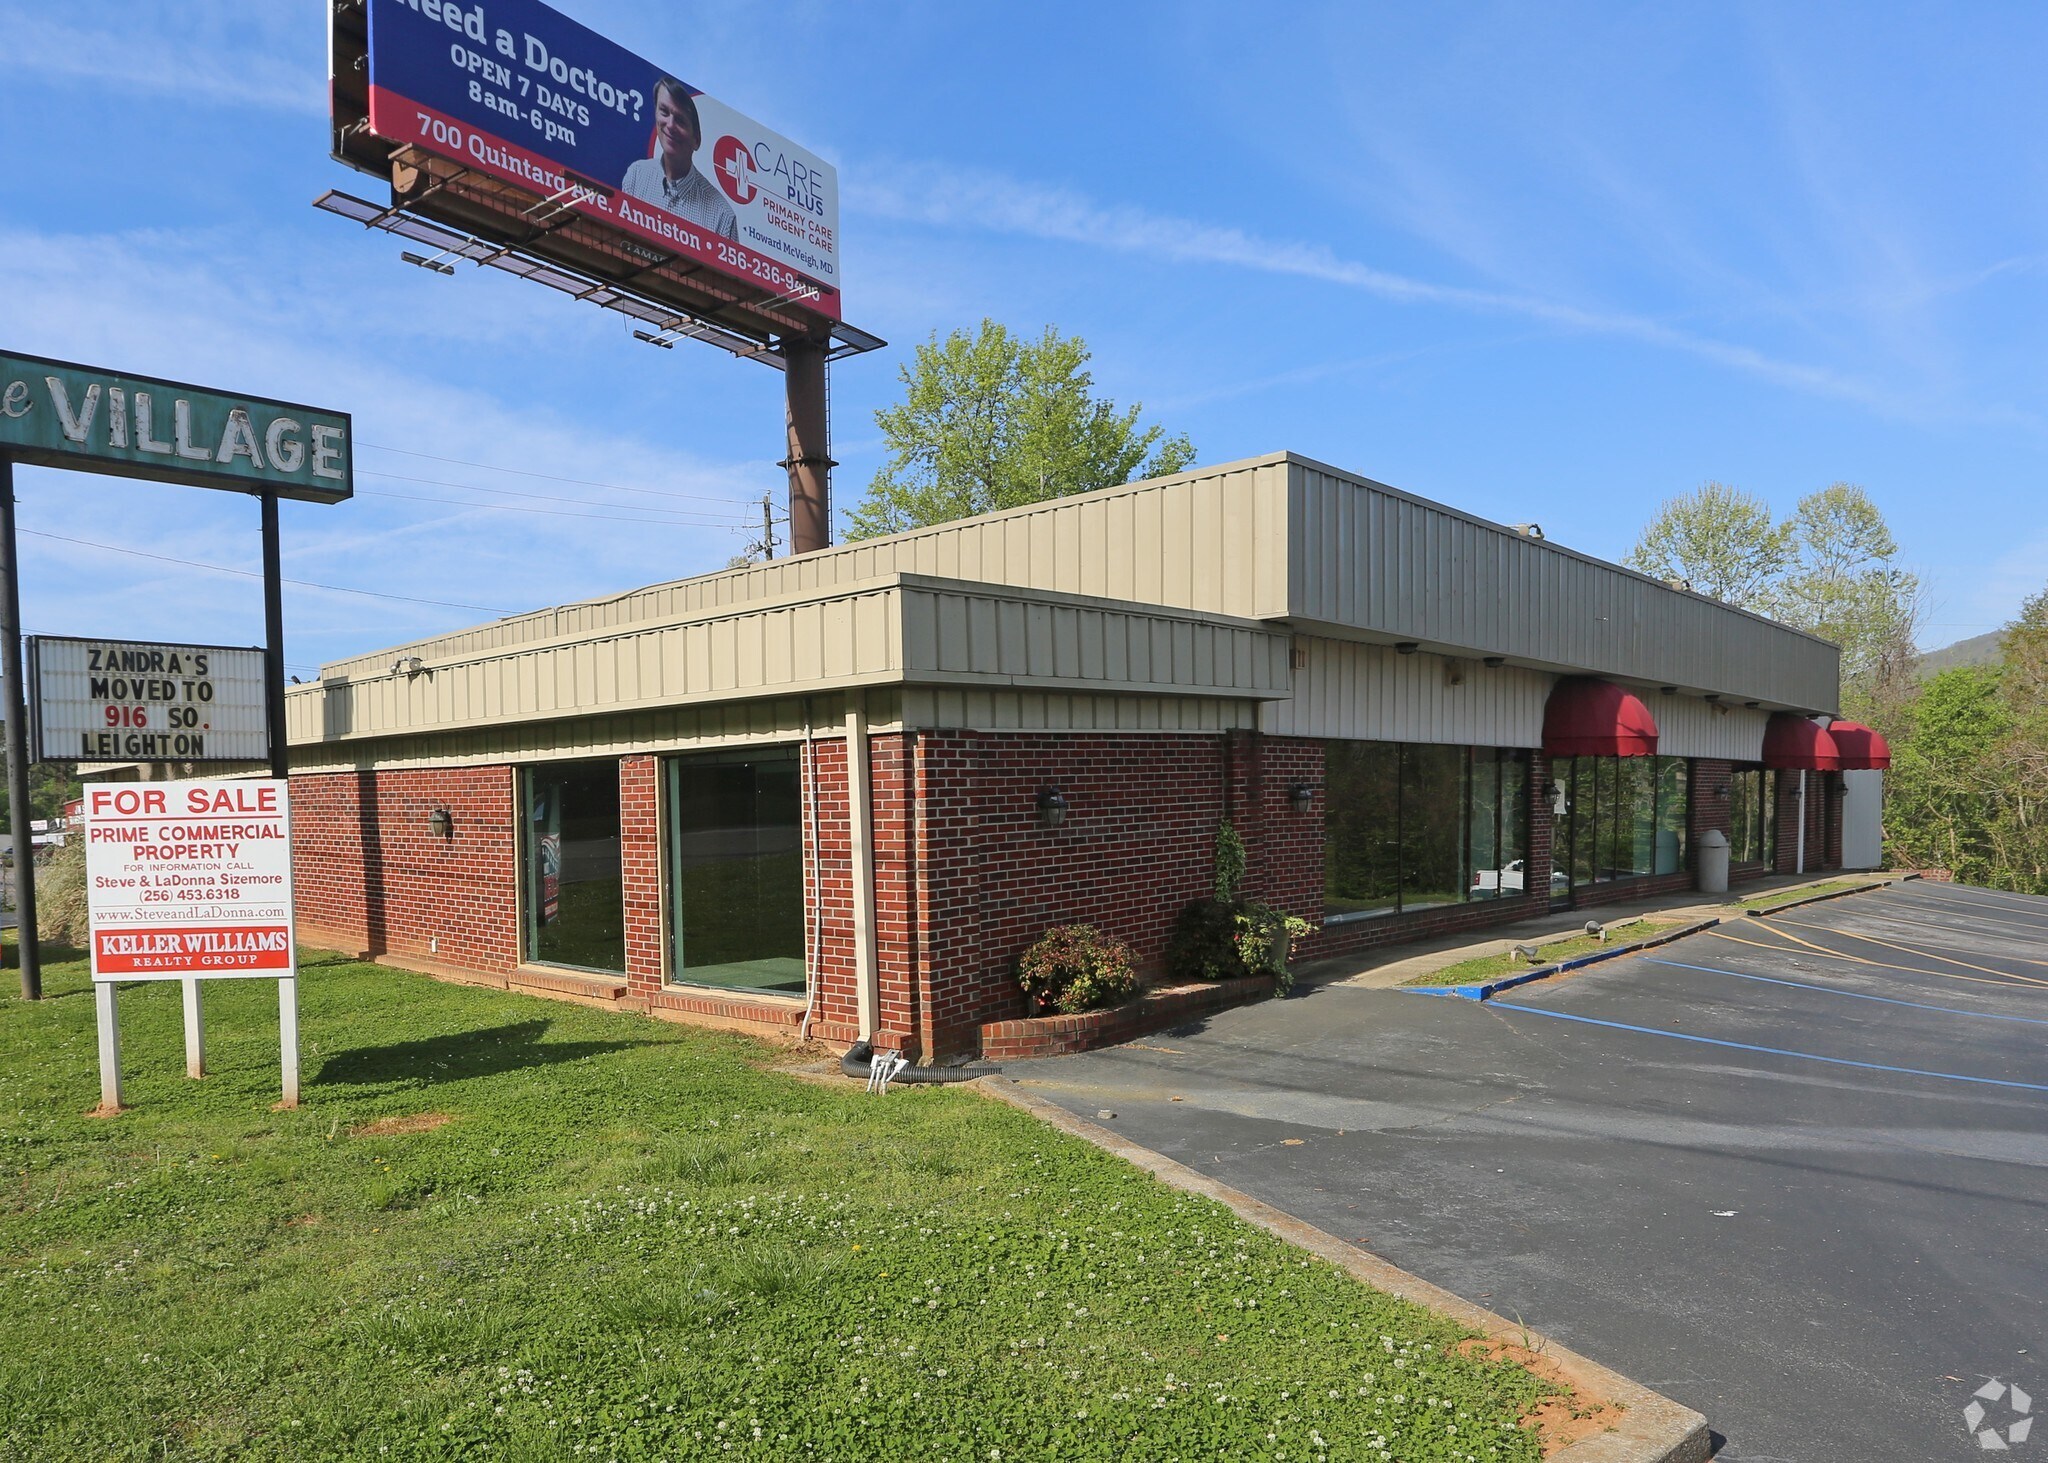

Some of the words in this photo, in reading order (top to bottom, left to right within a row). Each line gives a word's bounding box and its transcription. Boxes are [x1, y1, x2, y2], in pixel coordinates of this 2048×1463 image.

[450, 44, 511, 89] OPEN
[518, 75, 530, 97] 7
[537, 84, 590, 127] DAYS
[496, 29, 516, 59] a
[523, 33, 644, 121] Doctor?
[417, 112, 462, 149] 700
[618, 200, 701, 251] Anniston
[754, 142, 823, 201] CARE
[788, 185, 824, 216] PLUS
[763, 197, 806, 225] PRIMARY
[808, 220, 833, 241] CARE
[767, 213, 806, 239] URGENT
[808, 234, 833, 254] CARE
[748, 226, 782, 251] Howard
[783, 242, 819, 270] McVeigh,
[820, 259, 834, 275] MD
[45, 376, 345, 480] VILLAGE
[88, 649, 208, 675] ZANDRA'S
[91, 677, 176, 701] MOVED
[182, 681, 213, 702] TO
[105, 705, 147, 728] 916
[168, 706, 209, 729] SO.
[82, 733, 204, 756] LEIGHTON
[92, 790, 167, 815] FOR
[187, 788, 277, 814] SALE
[90, 827, 148, 843] PRIME
[159, 824, 285, 841] COMMERCIAL
[133, 843, 239, 861] PROPERTY
[124, 864, 144, 872] FOR
[149, 863, 221, 871] INFORMATION
[226, 862, 254, 870] CALL
[95, 876, 136, 888] Steve
[139, 876, 150, 887] &
[155, 874, 216, 887] LaDonna
[220, 873, 282, 885] Sizemore
[139, 890, 173, 904] (256)
[177, 888, 240, 901] 453.6318
[95, 906, 285, 921] www.SteveandLaDonna.com
[101, 934, 183, 955] KELLER
[184, 931, 287, 953] WILLIAMS
[133, 956, 193, 967] REALTY
[201, 954, 258, 965] GROUP
